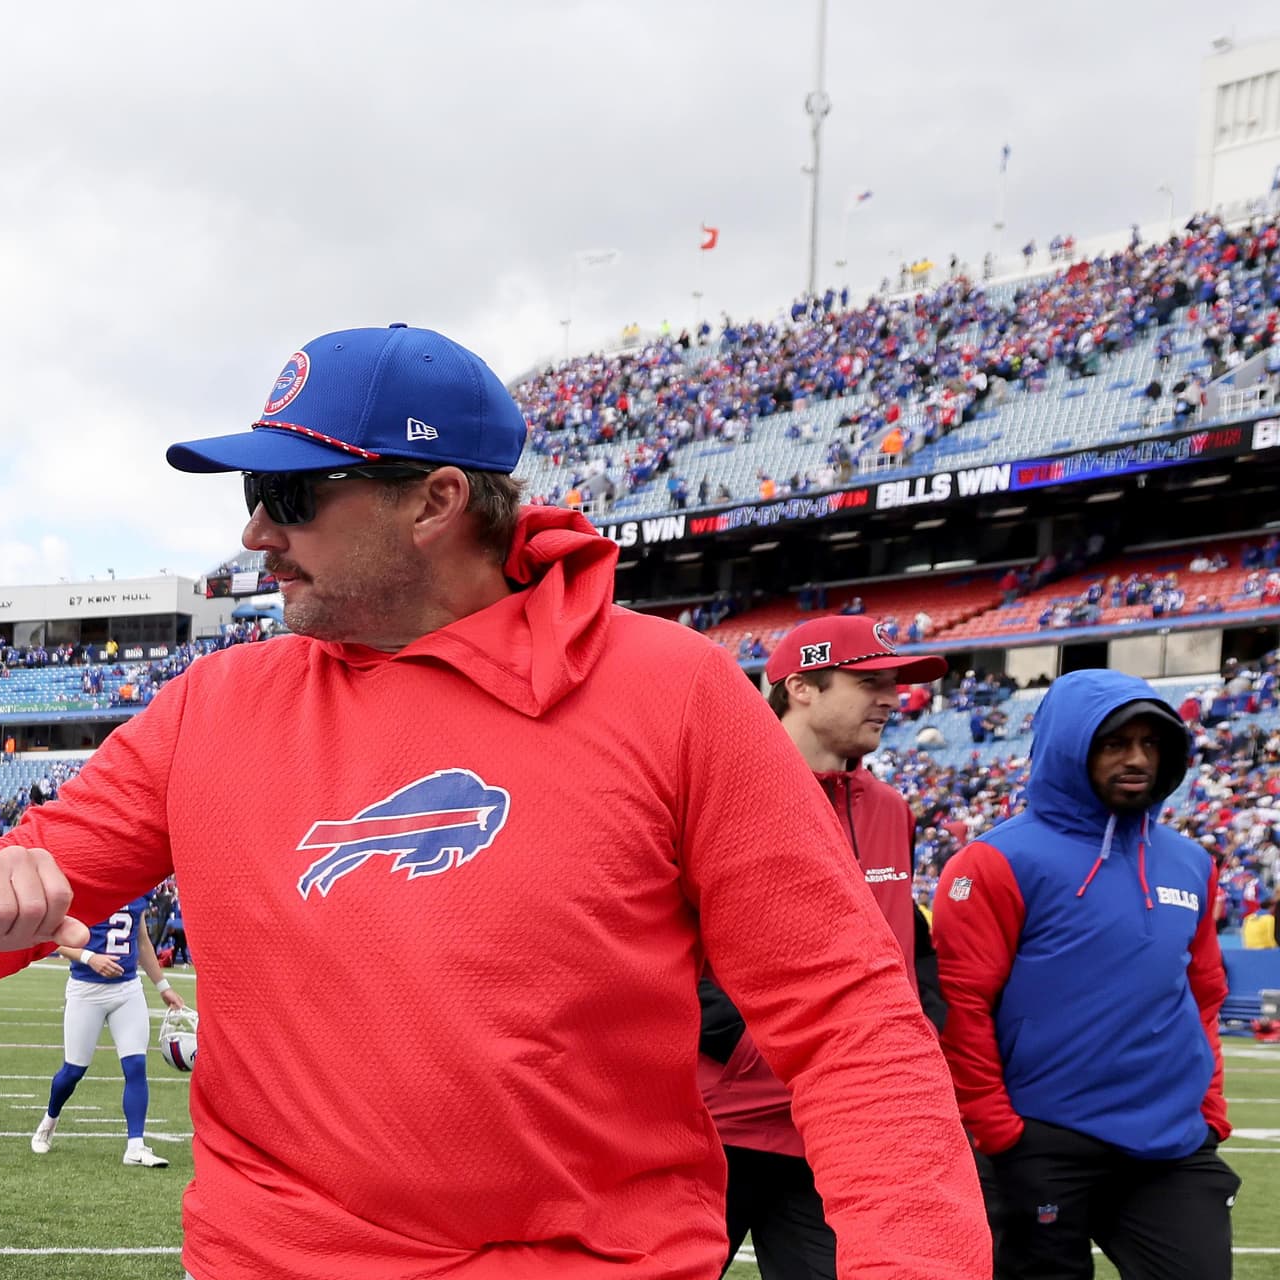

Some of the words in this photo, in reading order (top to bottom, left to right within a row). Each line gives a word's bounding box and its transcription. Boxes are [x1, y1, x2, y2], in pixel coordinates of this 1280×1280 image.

[874, 472, 952, 511] BILLS
[957, 463, 1013, 498] WIN
[642, 516, 686, 544] WIN
[88, 595, 118, 604] KENT
[122, 592, 152, 601] HULL
[864, 871, 909, 883] ARDINALS
[1155, 885, 1200, 912] BILLS
[105, 910, 134, 955] 2
